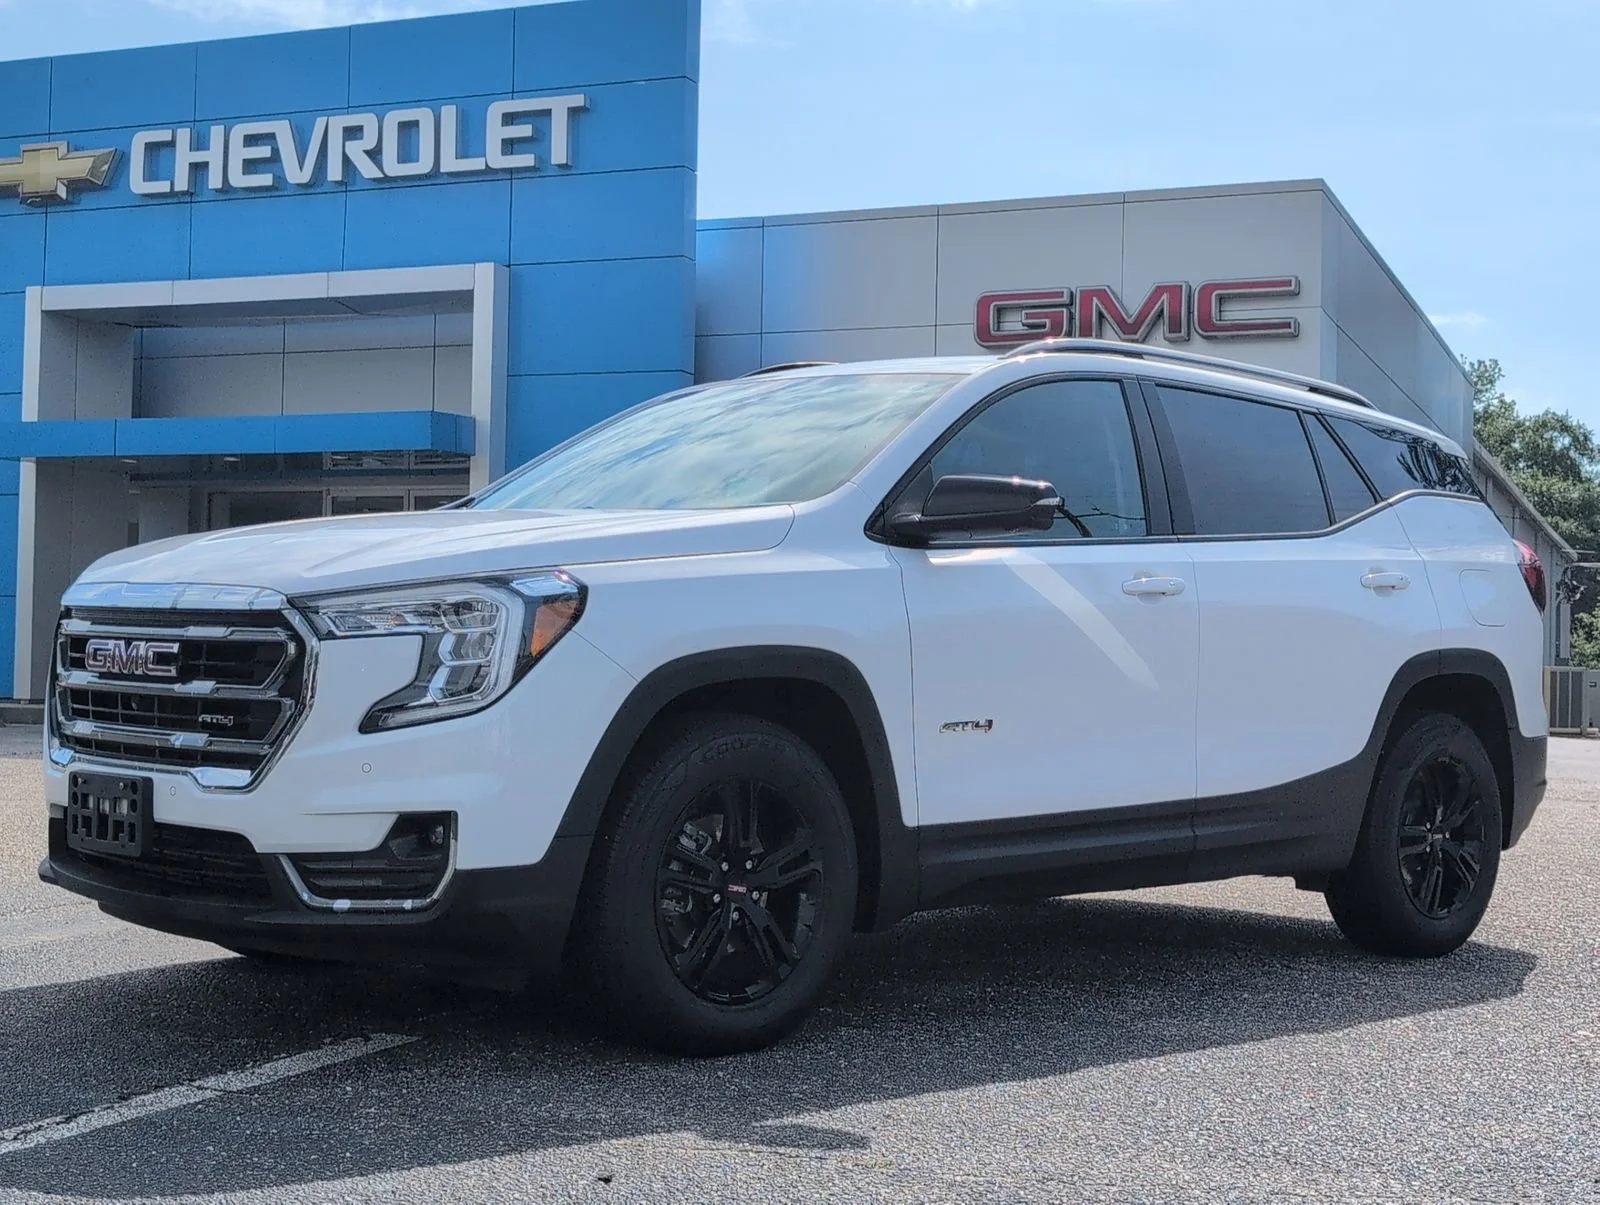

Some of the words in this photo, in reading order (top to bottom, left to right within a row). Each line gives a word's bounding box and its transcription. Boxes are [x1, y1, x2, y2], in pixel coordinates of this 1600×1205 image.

[129, 94, 588, 196] CHEVROLET
[974, 275, 1300, 348] GMC
[85, 638, 180, 677] GMC
